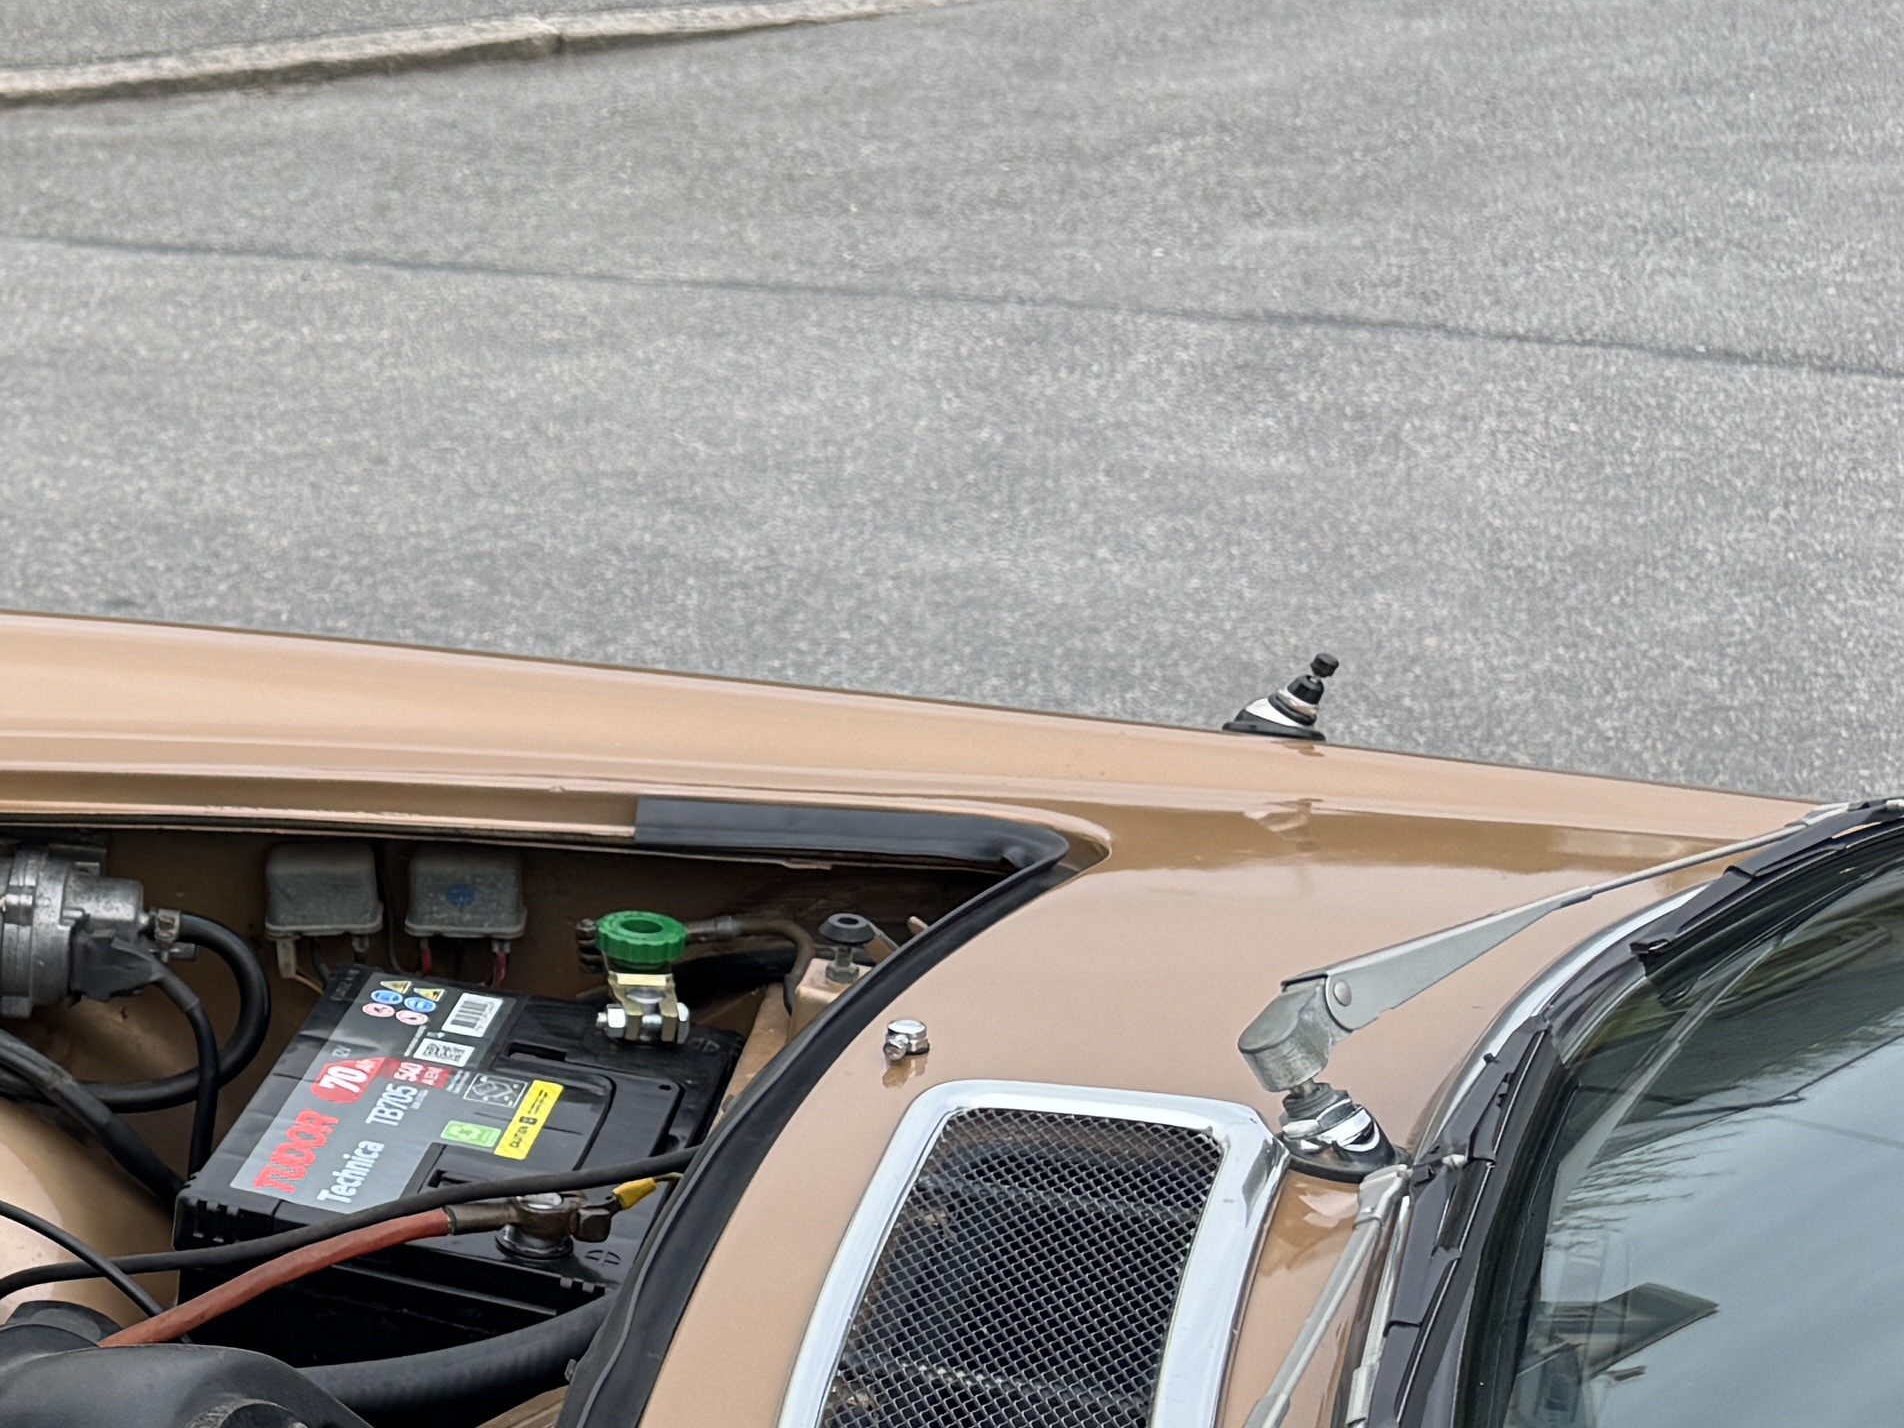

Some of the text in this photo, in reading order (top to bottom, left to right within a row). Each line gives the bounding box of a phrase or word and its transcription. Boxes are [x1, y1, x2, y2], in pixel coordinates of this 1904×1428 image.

[318, 1065, 369, 1093] 70
[393, 1061, 424, 1083] 540
[364, 1082, 418, 1127] TB705
[252, 1108, 340, 1194] TUDOR
[316, 1139, 386, 1204] Technica
